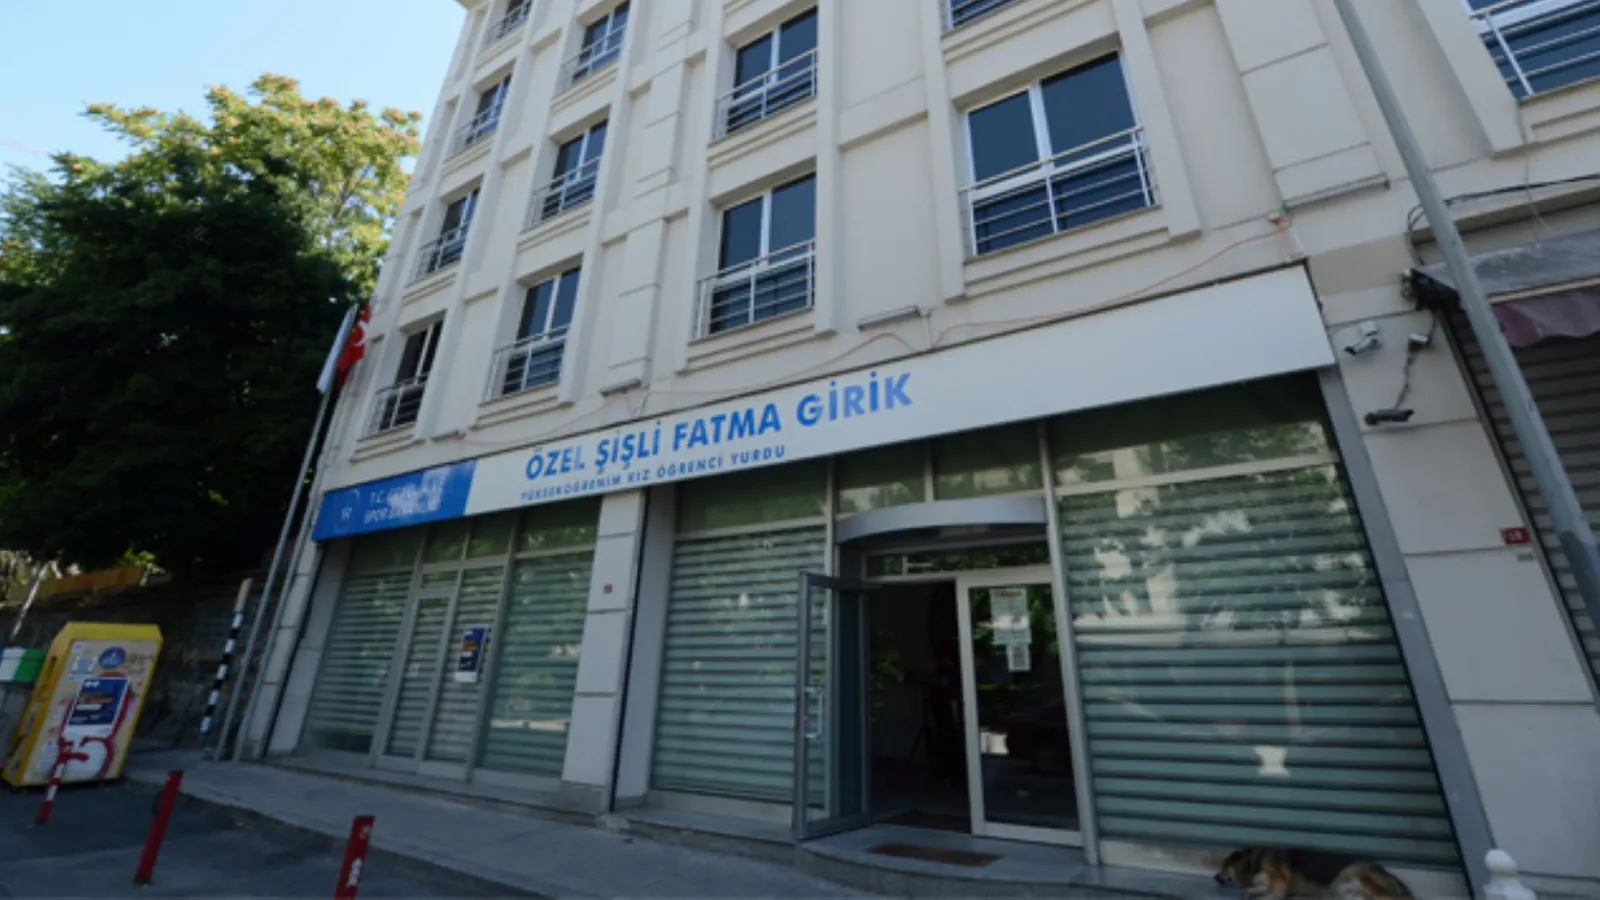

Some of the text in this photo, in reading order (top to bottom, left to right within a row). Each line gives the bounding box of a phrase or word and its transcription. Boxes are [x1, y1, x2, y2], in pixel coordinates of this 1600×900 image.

[525, 371, 913, 480] ÖZEL ŞİŞLİ FATMA GİRİK
[627, 469, 651, 483] KIZ
[731, 445, 786, 466] YURDU
